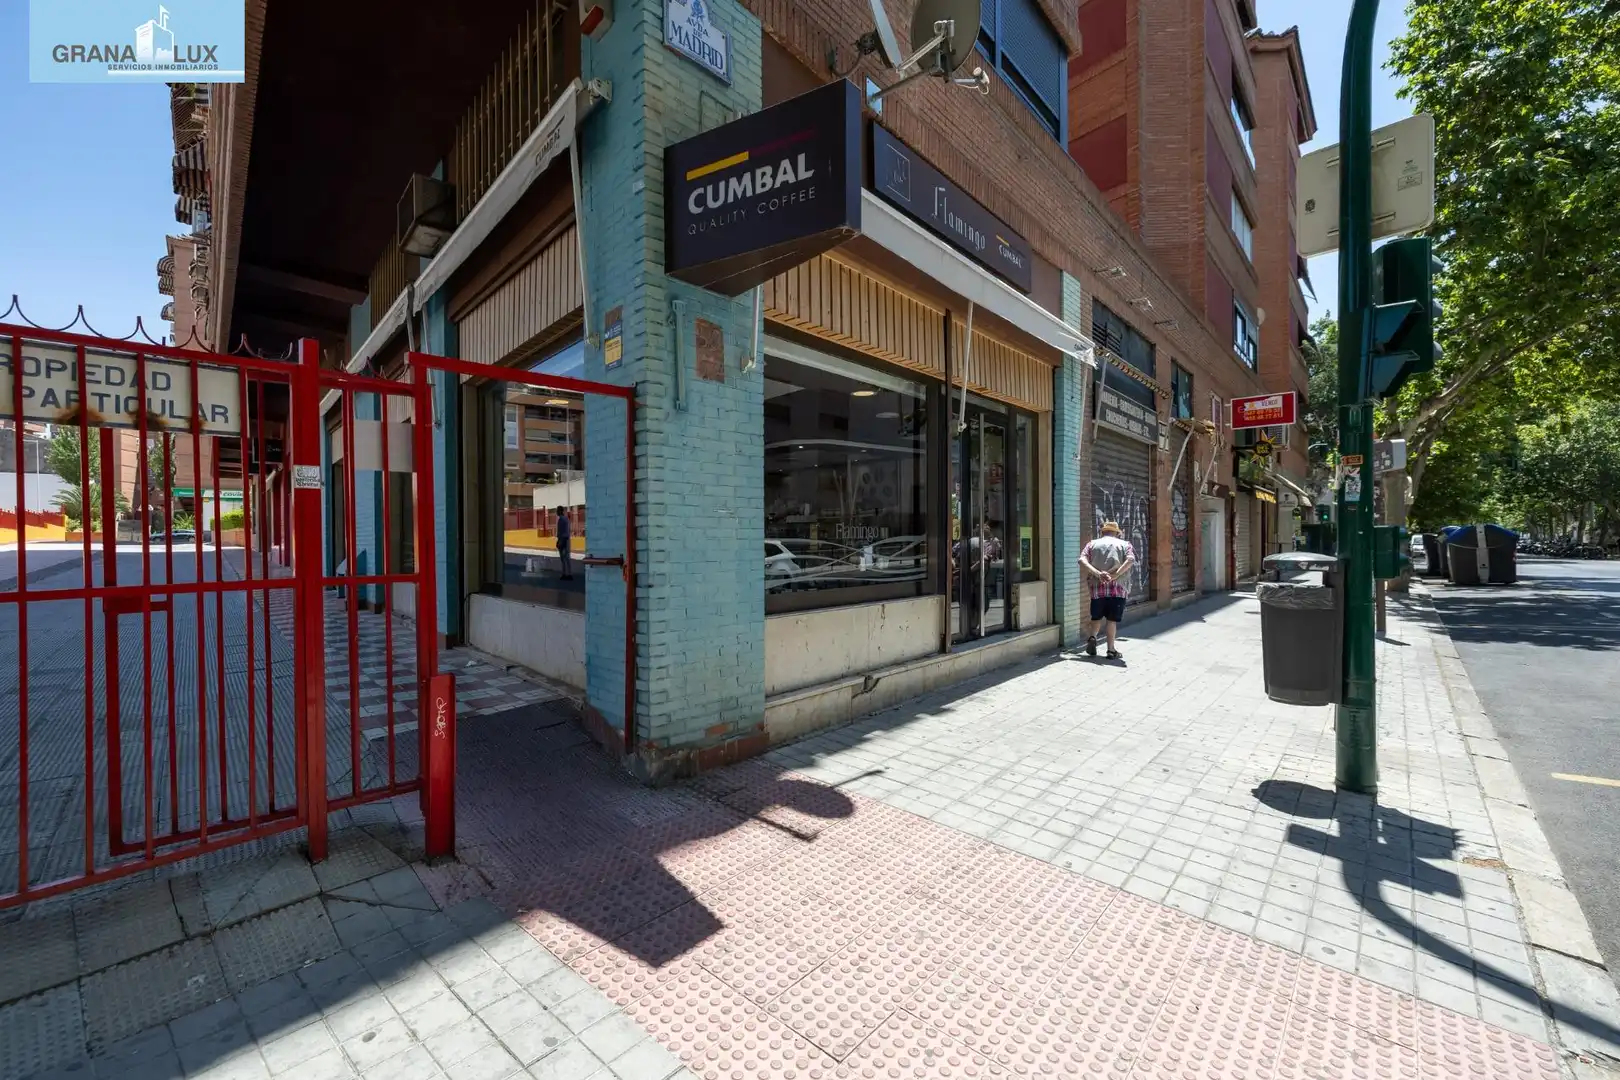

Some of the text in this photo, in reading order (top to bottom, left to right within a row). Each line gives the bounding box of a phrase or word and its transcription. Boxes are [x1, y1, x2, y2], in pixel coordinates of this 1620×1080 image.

[669, 20, 724, 70] MADRID
[687, 152, 815, 215] CUMBAL
[687, 187, 816, 236] QUALITY COFFEE
[931, 186, 986, 251] Flamingo
[998, 244, 1022, 269] CUMBAL
[0, 353, 171, 391] ROPIEDAD
[12, 385, 229, 424] PARTICULAR
[835, 522, 879, 542] Flamingo
